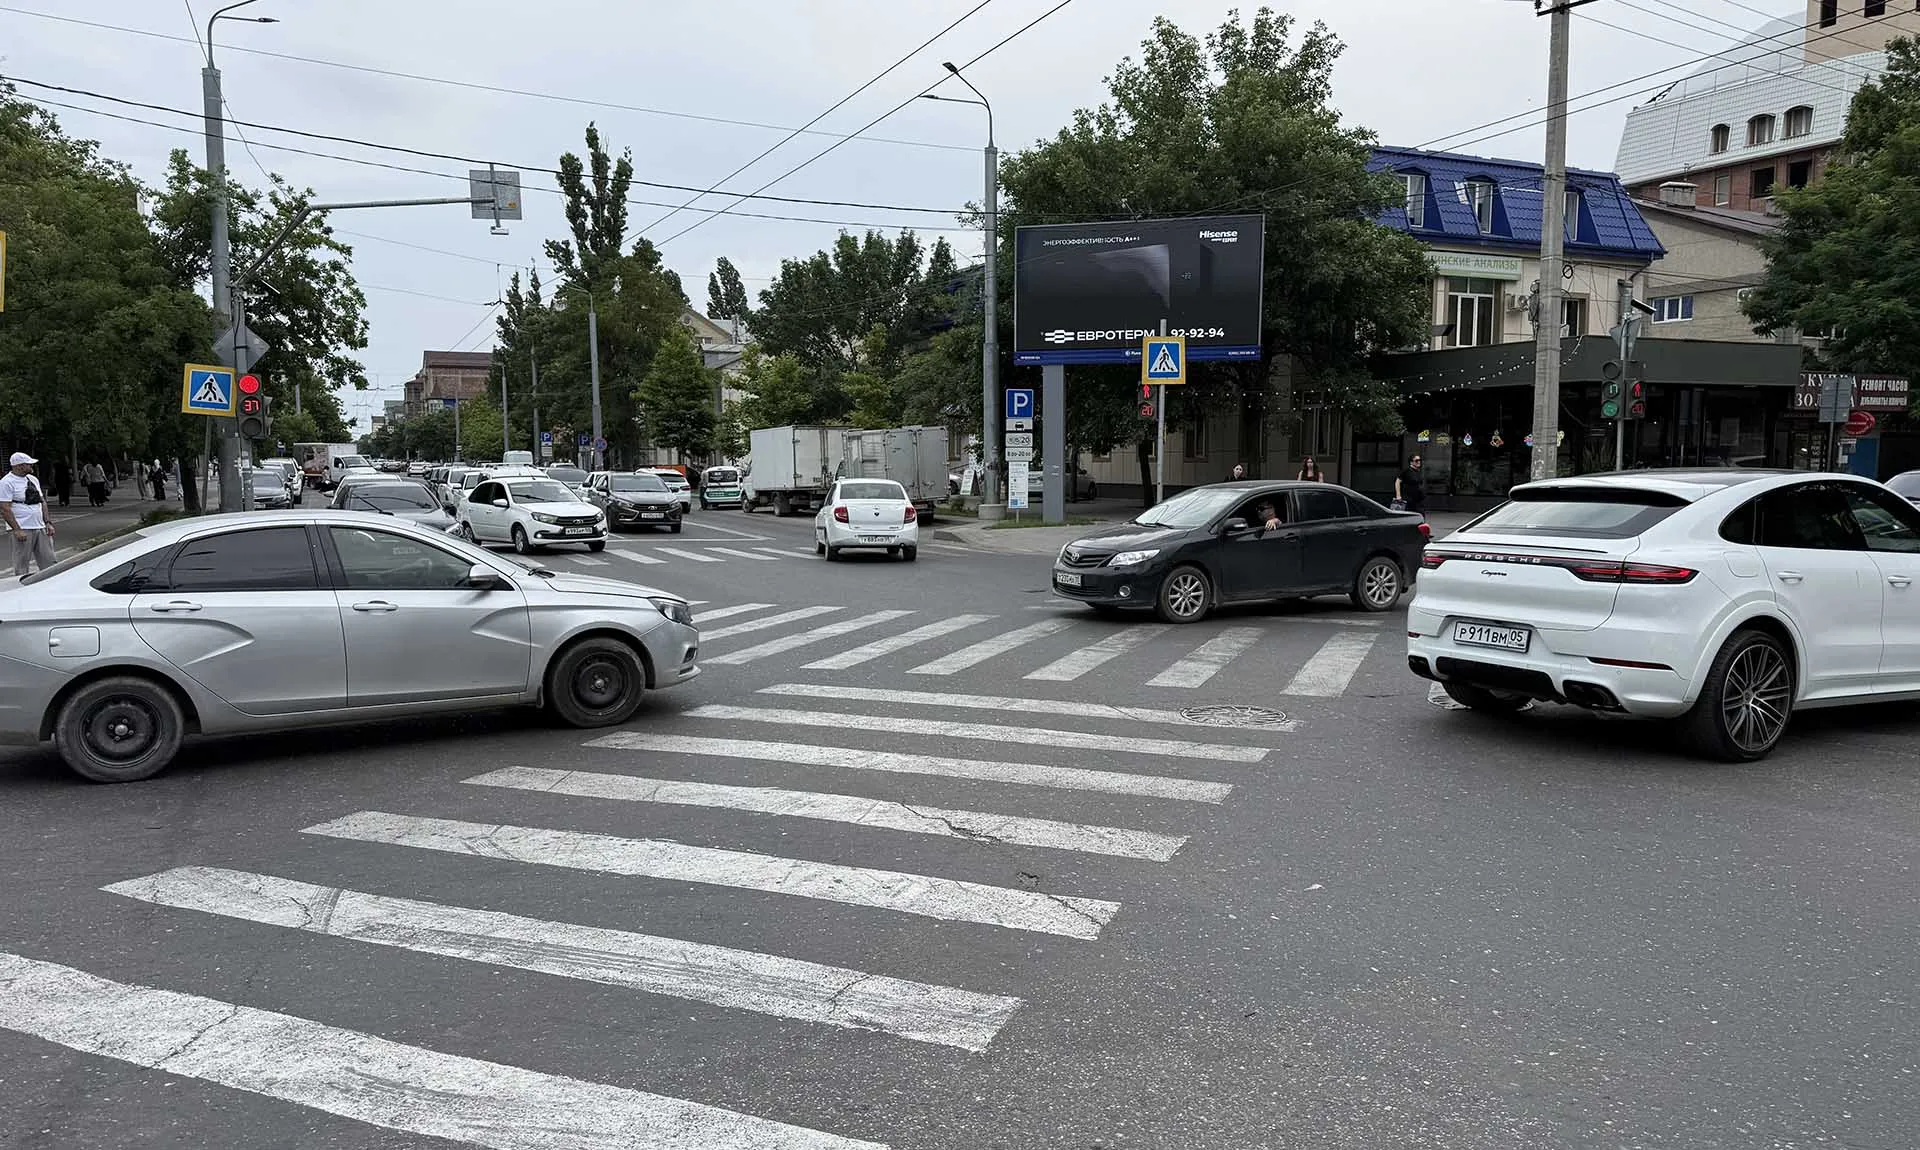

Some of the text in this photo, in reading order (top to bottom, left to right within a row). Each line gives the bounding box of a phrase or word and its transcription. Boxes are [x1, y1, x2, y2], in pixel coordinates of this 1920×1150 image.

[1199, 230, 1238, 239] Hisense
[1474, 257, 1518, 270] АНАЛИЗЫ
[1076, 329, 1156, 341] ЕВРОТЕРМ
[1861, 379, 1908, 392] РЕМОНТ ЧАСОВ
[244, 400, 259, 412] 37
[1013, 392, 1029, 416] P
[1141, 405, 1153, 416] 20
[543, 432, 550, 441] P
[1464, 553, 1541, 563] PORSCHE
[1510, 630, 1523, 642] 05
